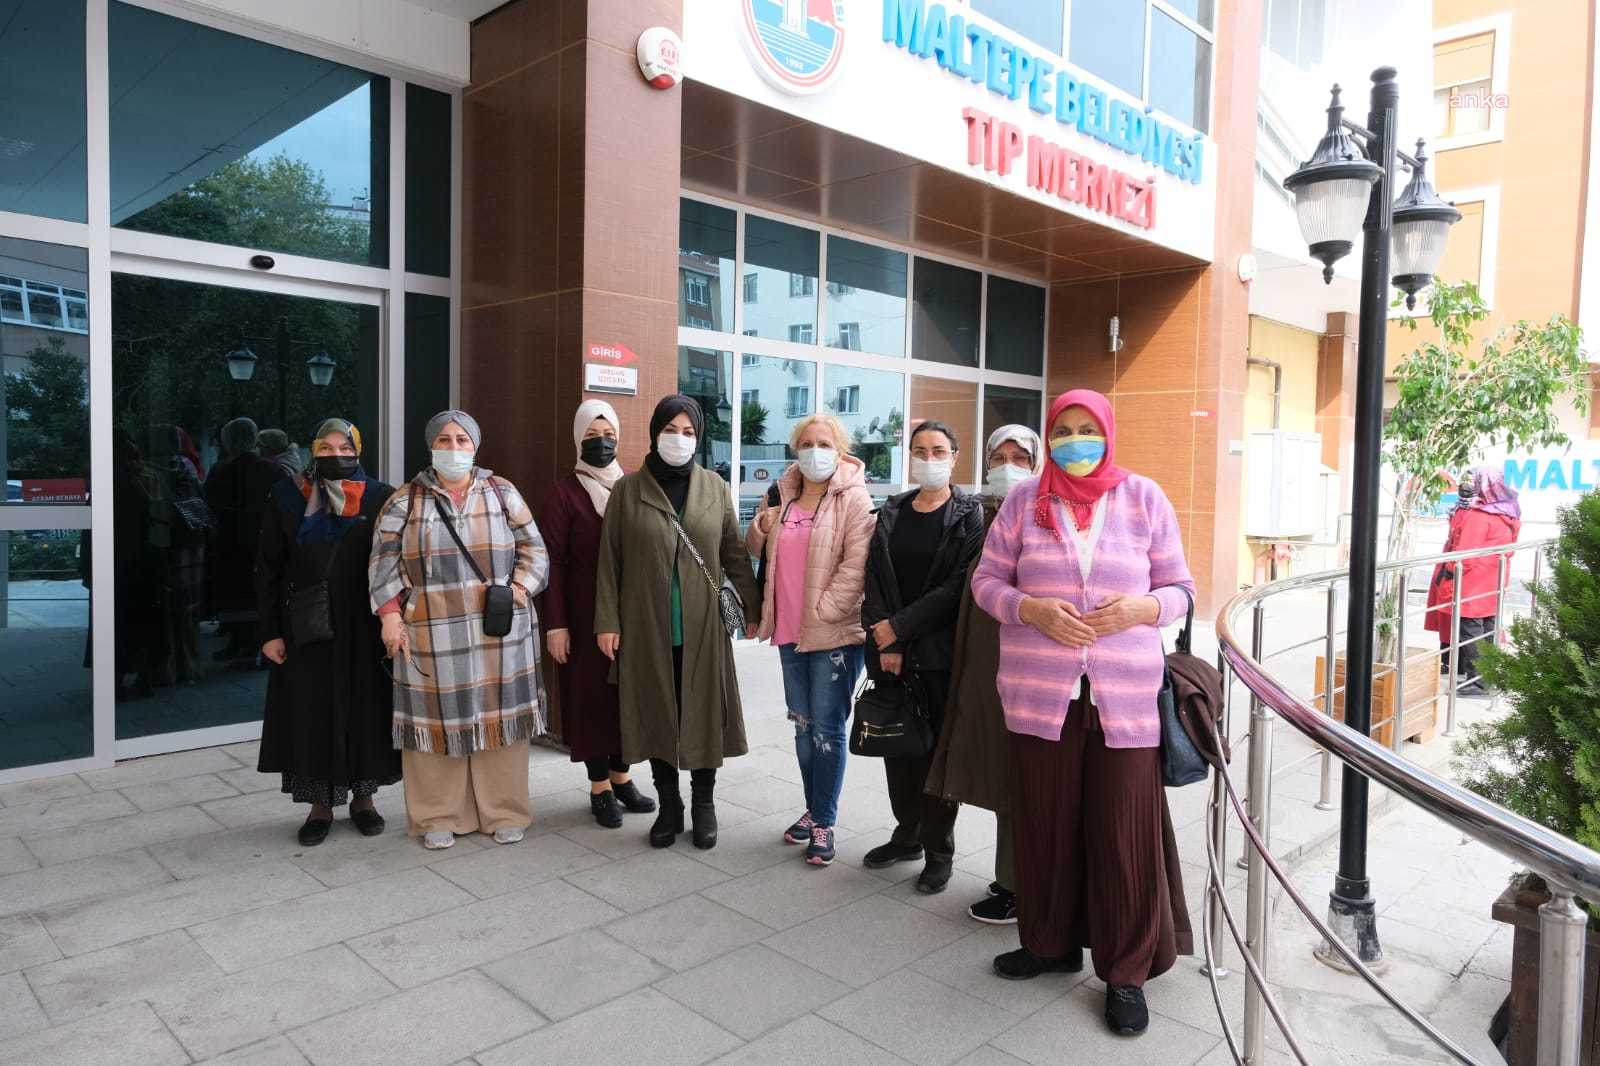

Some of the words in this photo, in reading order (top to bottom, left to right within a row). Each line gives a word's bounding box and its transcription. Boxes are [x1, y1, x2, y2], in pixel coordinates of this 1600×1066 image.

[883, 0, 1054, 115] MALTEPE
[1056, 70, 1204, 185] BELEDİYESİ
[962, 106, 1023, 176] TIP
[1027, 134, 1157, 231] MERKEZİ
